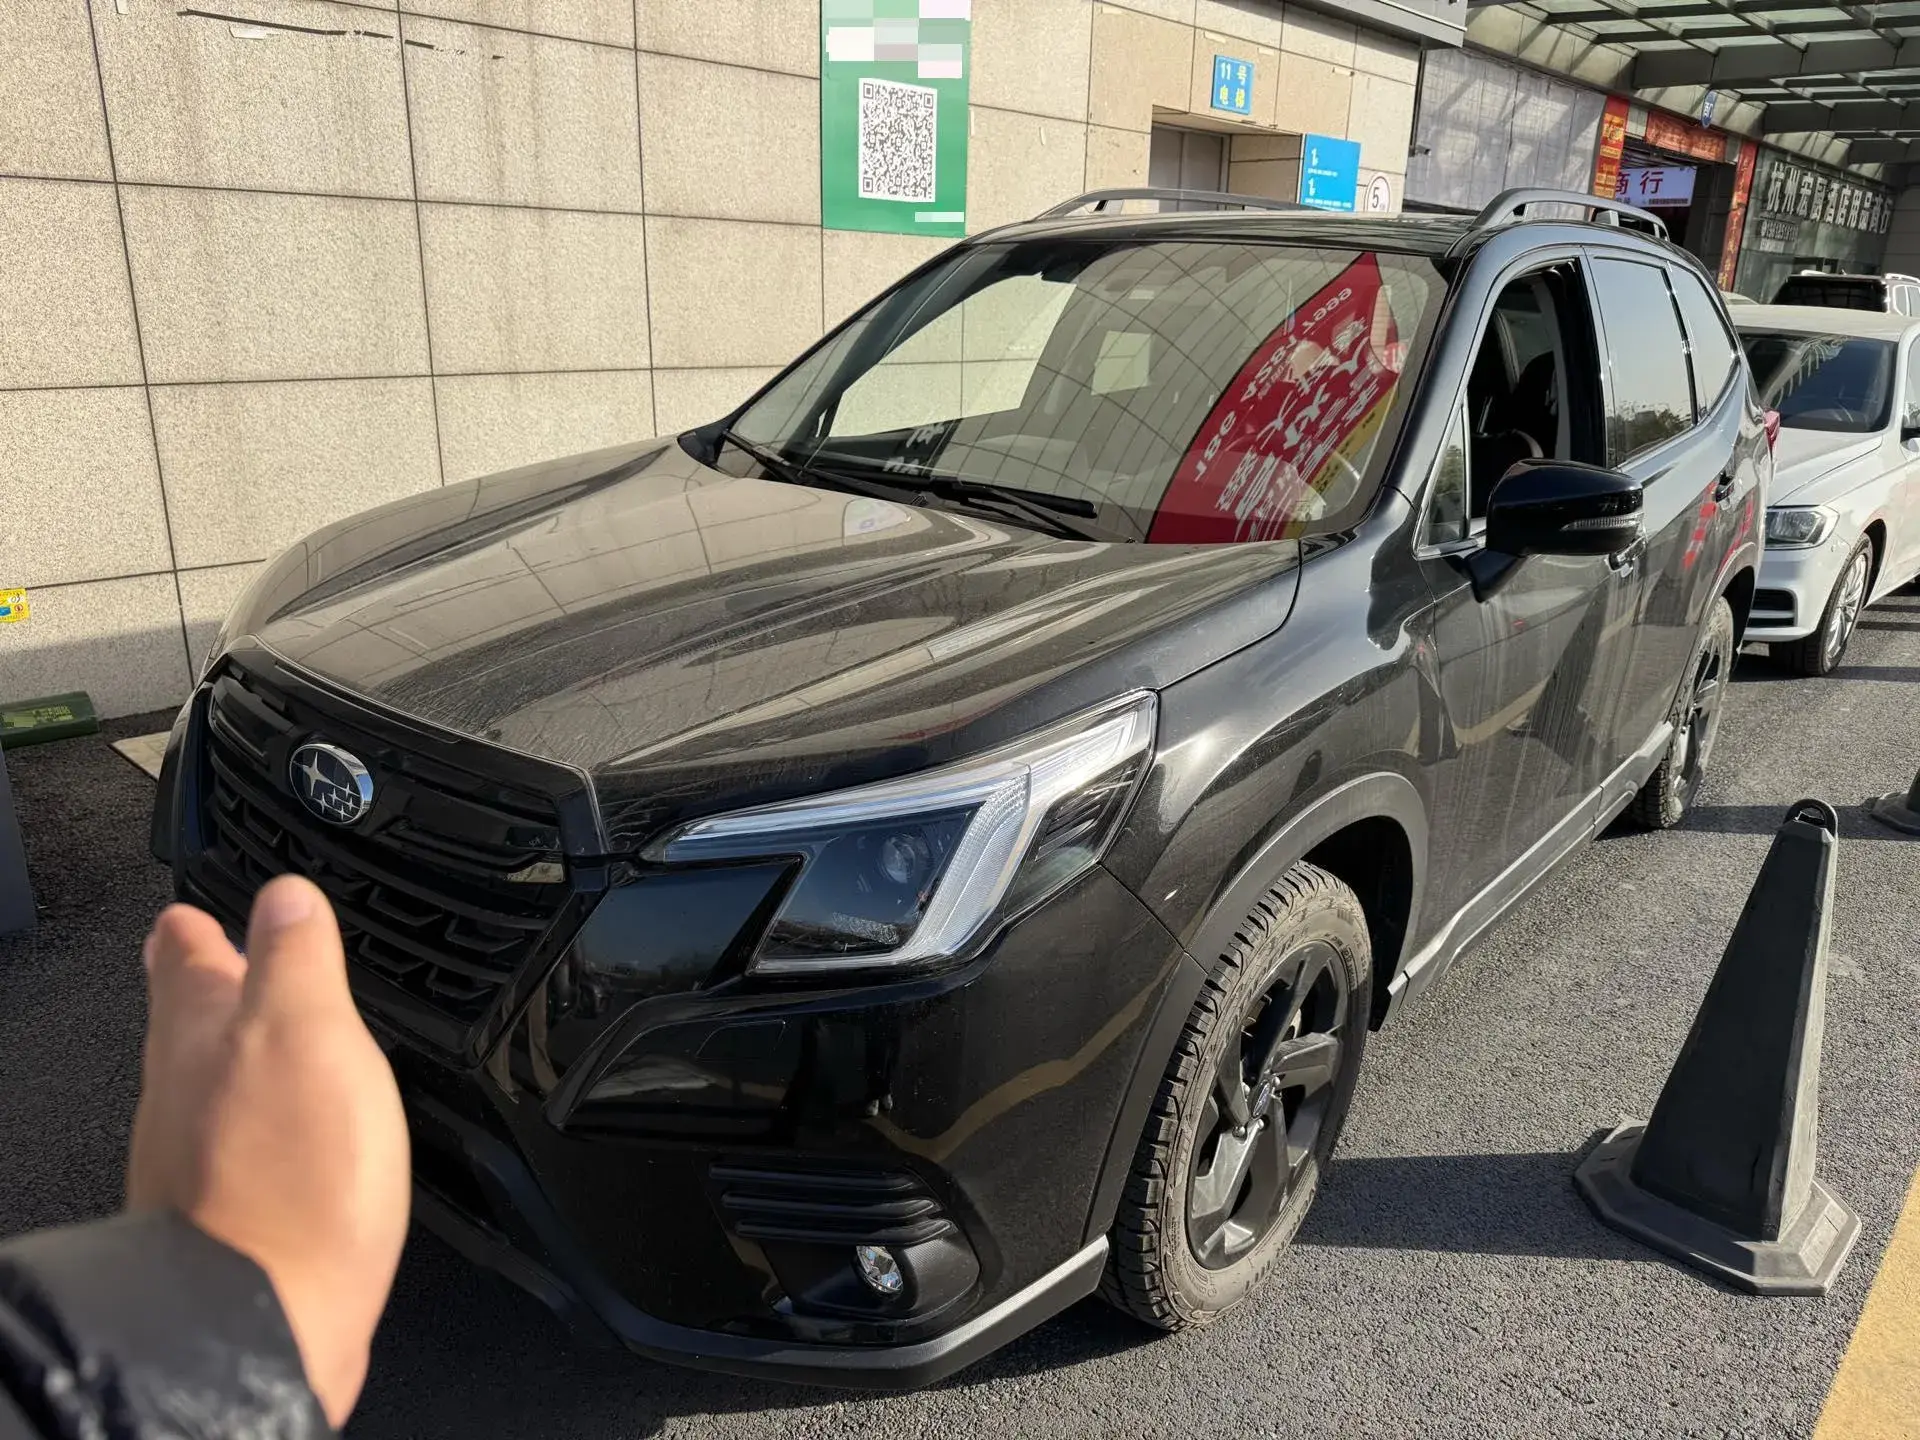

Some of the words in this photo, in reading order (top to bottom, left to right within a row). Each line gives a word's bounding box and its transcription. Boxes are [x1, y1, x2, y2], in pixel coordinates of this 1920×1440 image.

[1220, 62, 1247, 86] 11号
[1219, 84, 1245, 108] 电梯
[1371, 186, 1380, 209] 5
